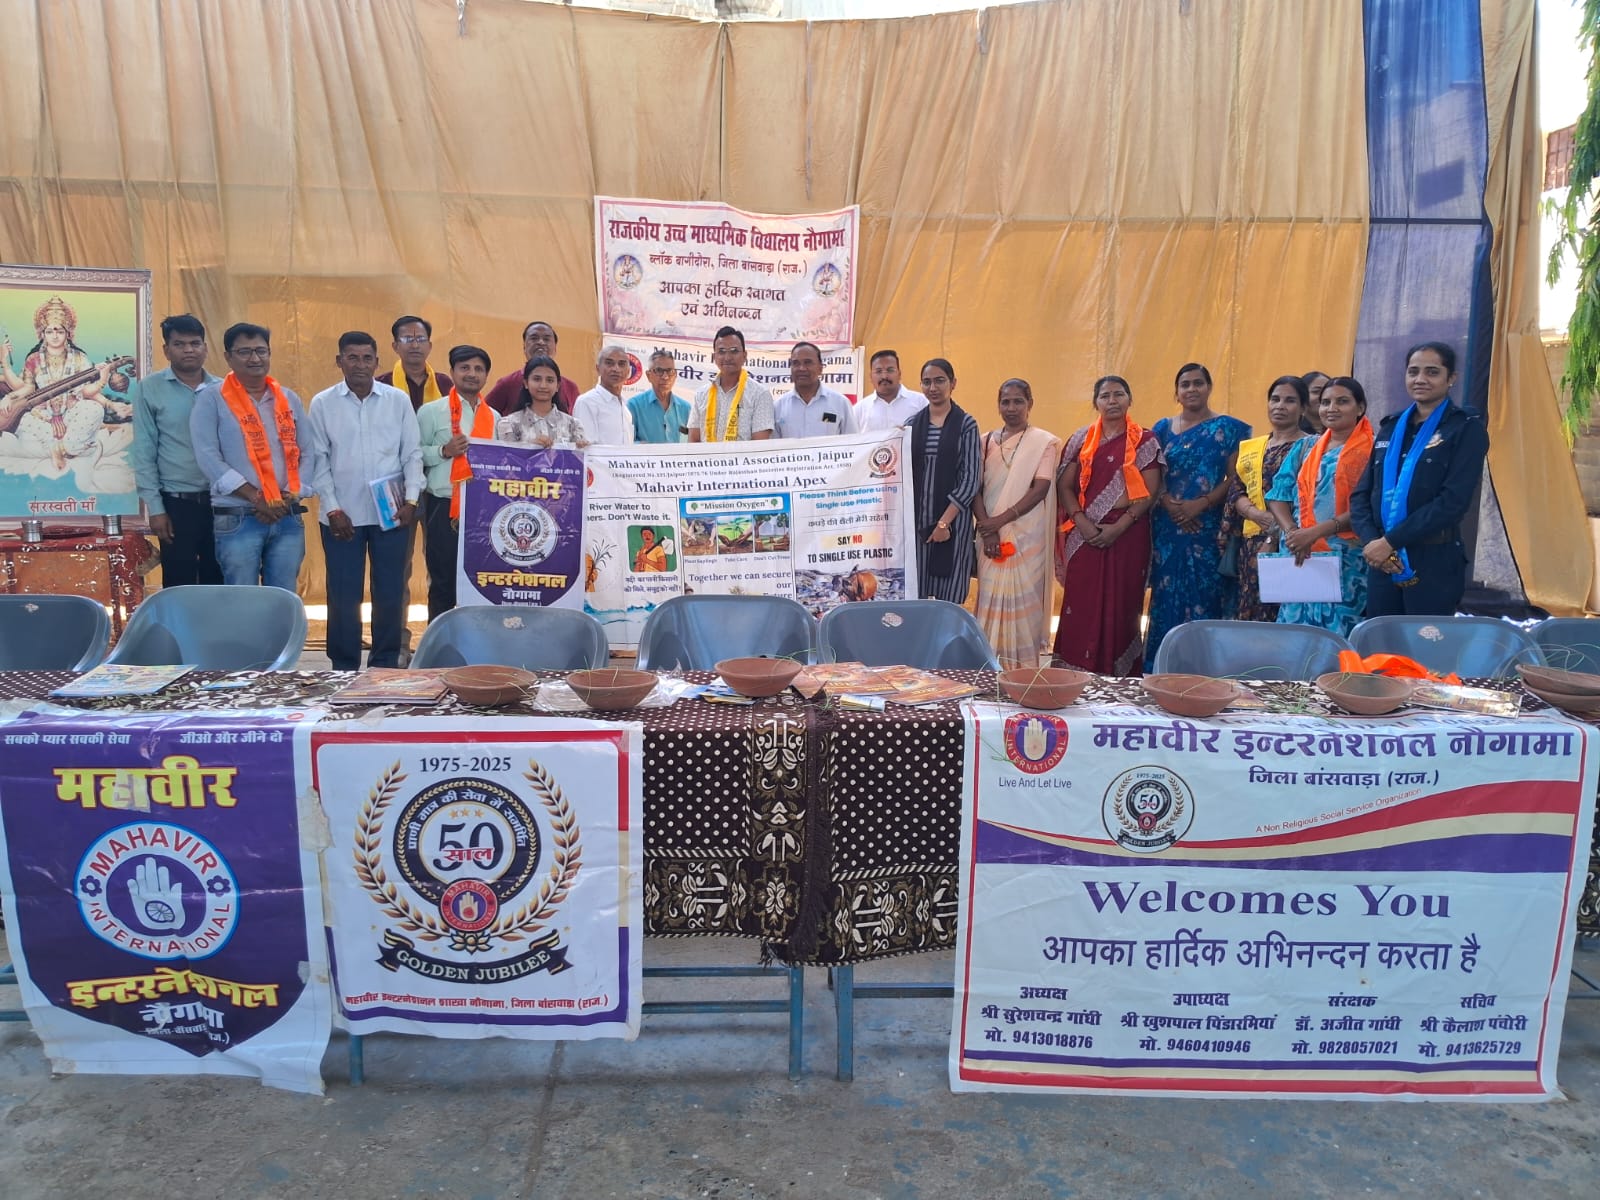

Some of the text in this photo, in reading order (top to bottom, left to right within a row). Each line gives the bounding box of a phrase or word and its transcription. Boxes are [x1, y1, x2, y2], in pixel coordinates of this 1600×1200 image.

[609, 216, 846, 251] राजकीय उच्च माध्यमिक विद्यालय नौगामा
[718, 254, 739, 270] जिला
[659, 279, 785, 302] आपका हार्दिक स्वागत
[681, 299, 762, 320] एवं अभिनन्दन
[608, 450, 854, 469] Mahavir International Association, Jaipur
[488, 476, 562, 500] महावीर
[636, 476, 827, 493] Mahavir International Apex
[849, 487, 874, 495] Before
[29, 497, 96, 513] सरस्वती माँ
[642, 503, 651, 511] to
[815, 502, 839, 510] Single
[856, 497, 882, 505] Plastic
[632, 513, 660, 521] Waste
[662, 513, 671, 521] it.
[838, 534, 863, 545] SAY NO
[808, 548, 893, 563] TO SINGLE USE PLASTIC
[477, 570, 567, 588] इन्टरनेशनल
[688, 572, 728, 583] Together
[762, 571, 791, 580] secure
[502, 587, 542, 600] नौगामा
[5, 732, 40, 745] सबको
[43, 734, 68, 745] प्यार
[108, 731, 131, 744] सेवा
[180, 729, 283, 744] जीओ और जीने दो
[1093, 720, 1575, 761] महावीर इन्टरनेशनल नौगामा
[1007, 738, 1066, 772] INTERNATIONAL
[419, 756, 512, 772] 1975-2025
[53, 755, 238, 809] महावीर
[999, 777, 1072, 788] Live And Let Live
[1249, 765, 1440, 788] जिला बांसवाड़ा (राज.)
[440, 790, 458, 803] की
[461, 788, 488, 802] सेवा
[489, 796, 505, 809] में
[1137, 793, 1161, 810] 50
[1255, 788, 1423, 833] A Non Religious Social Service Organization
[89, 827, 219, 876] MAHAVIR
[433, 822, 504, 871] 50
[441, 847, 494, 862] साल
[447, 881, 490, 898] MAHAVIR
[1082, 880, 1452, 918] Welcomes You
[89, 902, 231, 955] INTERNATIONAL
[1042, 927, 1482, 974] आपका हार्दिक अभिनन्दन करता है
[397, 950, 551, 981] GOLDEN JUBILEE
[65, 966, 280, 1009] इन्टरनेशनल
[1020, 986, 1069, 1001] अध्यक्ष
[345, 992, 379, 1005] महावीर
[511, 996, 535, 1008] जिला
[1173, 992, 1231, 1007] उपाध्यक्ष
[1328, 991, 1378, 1008] संरक्षक
[1460, 993, 1498, 1009] सचिव
[981, 1004, 1001, 1019] श्री
[1003, 1006, 1064, 1025] सुरेशचन्द्र
[1120, 1012, 1140, 1028] श्री
[1142, 1014, 1203, 1031] खुशपाल
[1295, 1015, 1314, 1032] डॉ.
[1320, 1014, 1365, 1031] अजीत
[1419, 1015, 1440, 1033] श्री
[1442, 1015, 1486, 1033] कैलाश
[984, 1027, 1093, 1049] मो. 9413018876
[1139, 1036, 1251, 1053] मो. 9460410946
[1291, 1039, 1398, 1055] मो. 9828057021
[1418, 1040, 1521, 1058] मो. 9413625729
